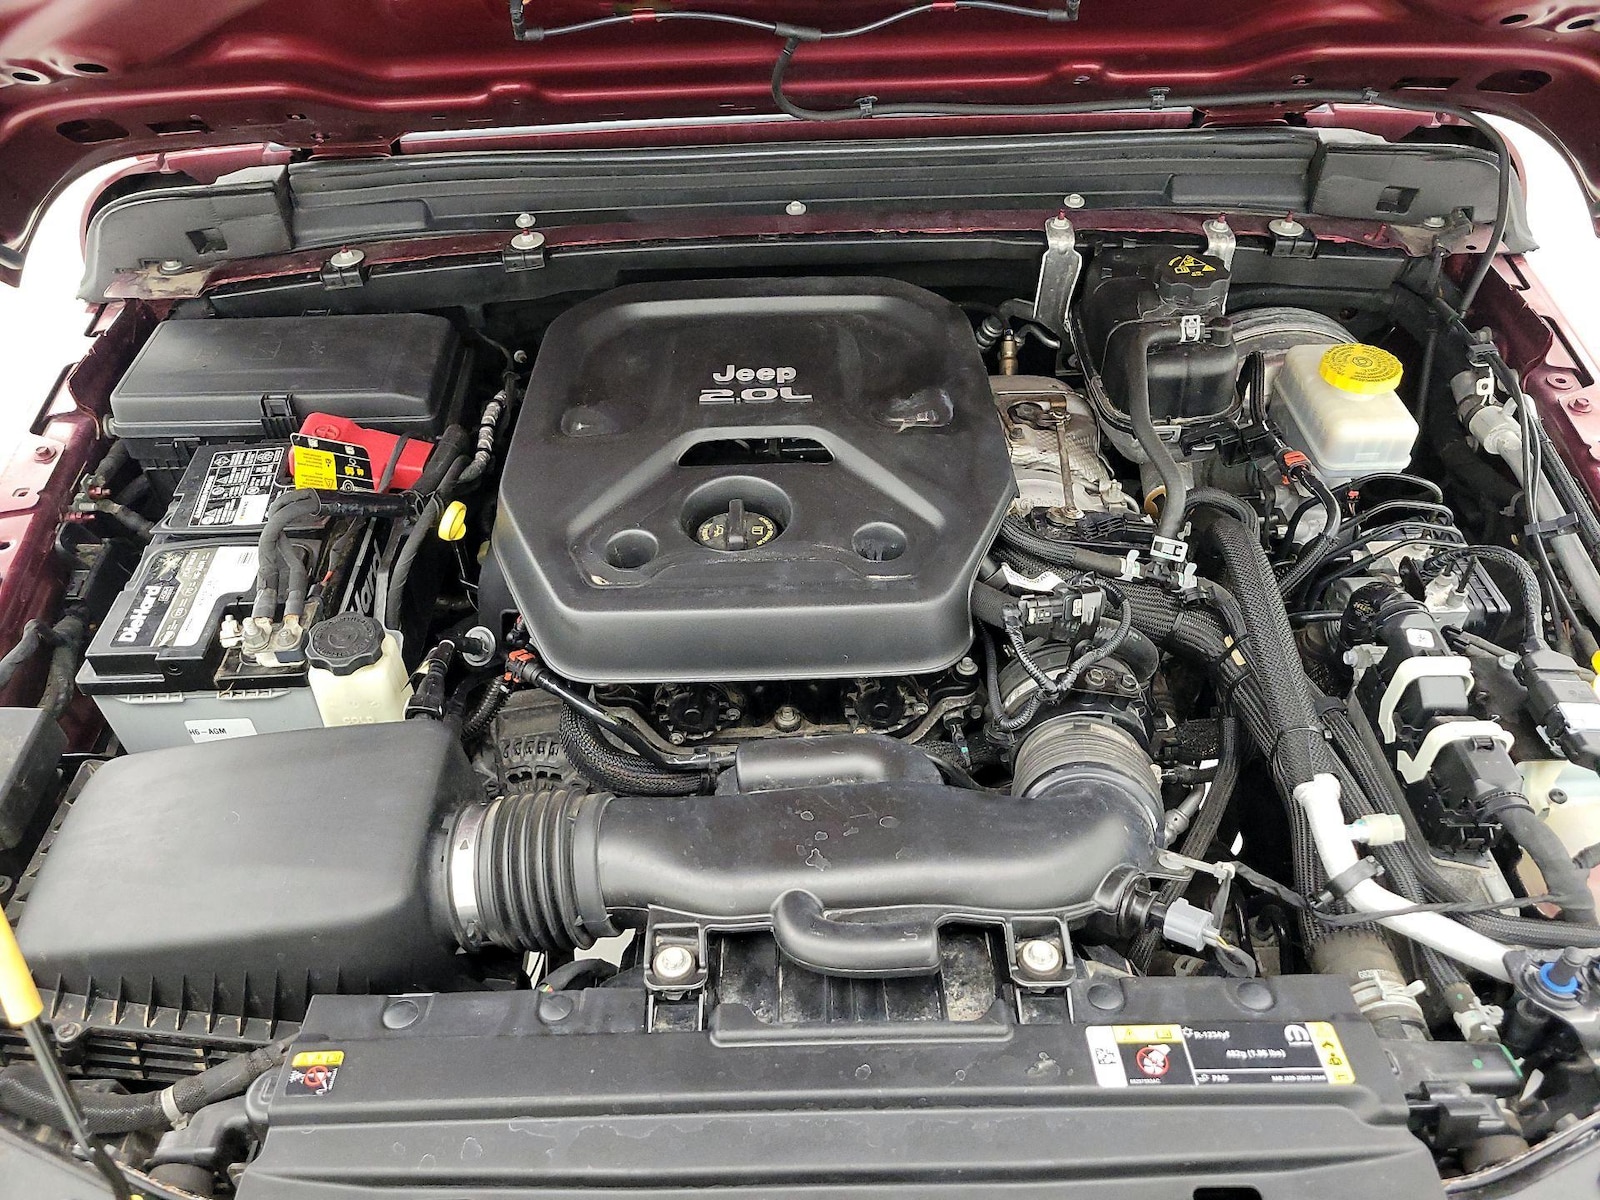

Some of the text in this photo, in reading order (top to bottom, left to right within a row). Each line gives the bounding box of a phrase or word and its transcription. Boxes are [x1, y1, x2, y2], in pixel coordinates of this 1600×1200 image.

[712, 364, 797, 384] Jeep
[699, 386, 813, 404] 2.0L
[117, 585, 162, 642] DieHard
